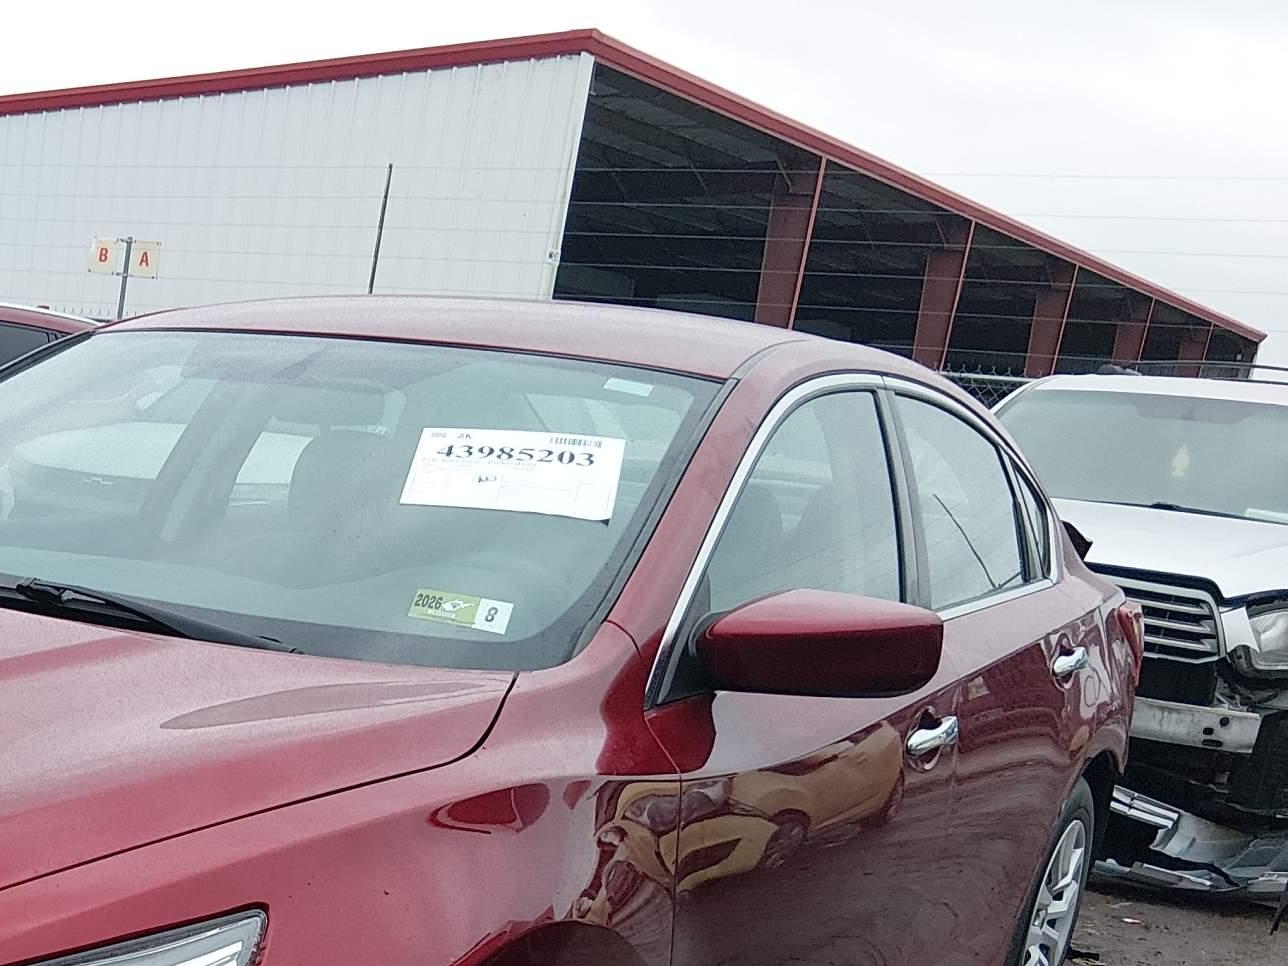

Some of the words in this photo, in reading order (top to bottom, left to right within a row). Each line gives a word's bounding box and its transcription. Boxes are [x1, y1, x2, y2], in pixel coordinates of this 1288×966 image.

[98, 247, 109, 263] B
[138, 251, 149, 267] A
[436, 444, 596, 467] 43985203
[413, 593, 444, 610] 2026
[484, 606, 499, 623] 8
